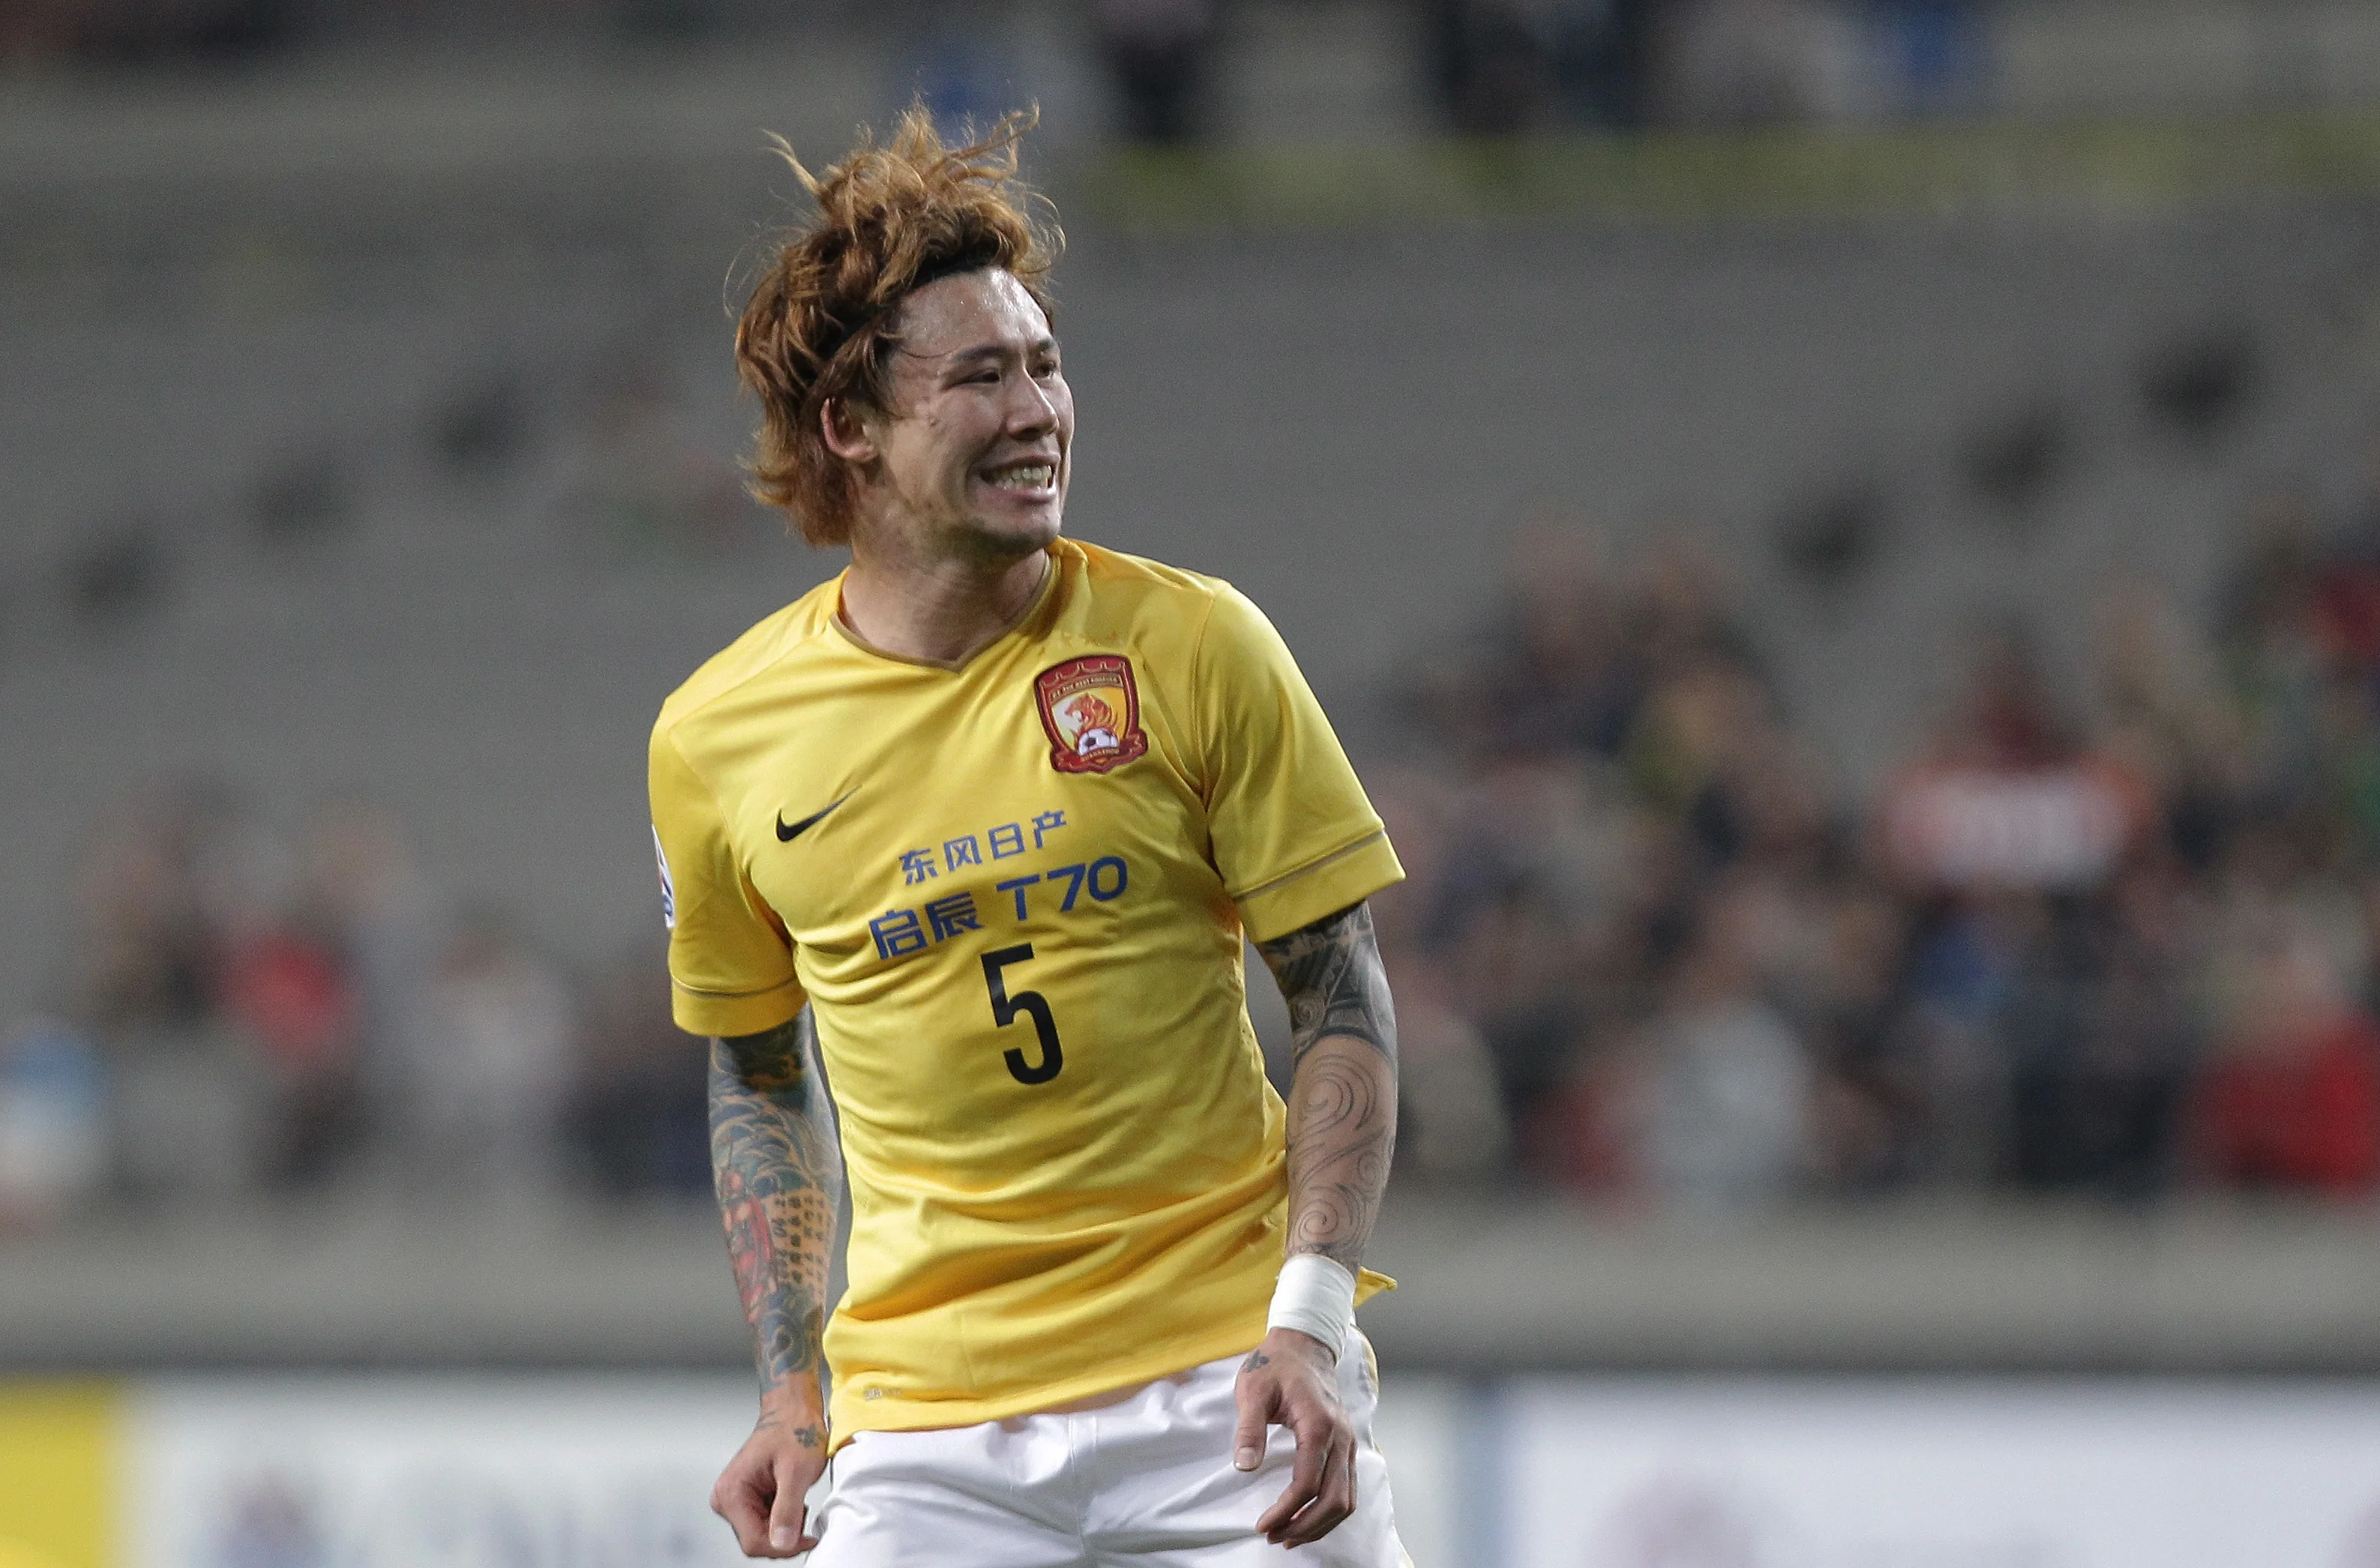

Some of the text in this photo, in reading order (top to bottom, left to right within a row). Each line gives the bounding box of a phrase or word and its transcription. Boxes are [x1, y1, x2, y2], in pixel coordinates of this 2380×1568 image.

[899, 809, 1067, 885] 东风日产
[869, 855, 1128, 959] 启辰 T70
[980, 942, 1063, 1085] 5
